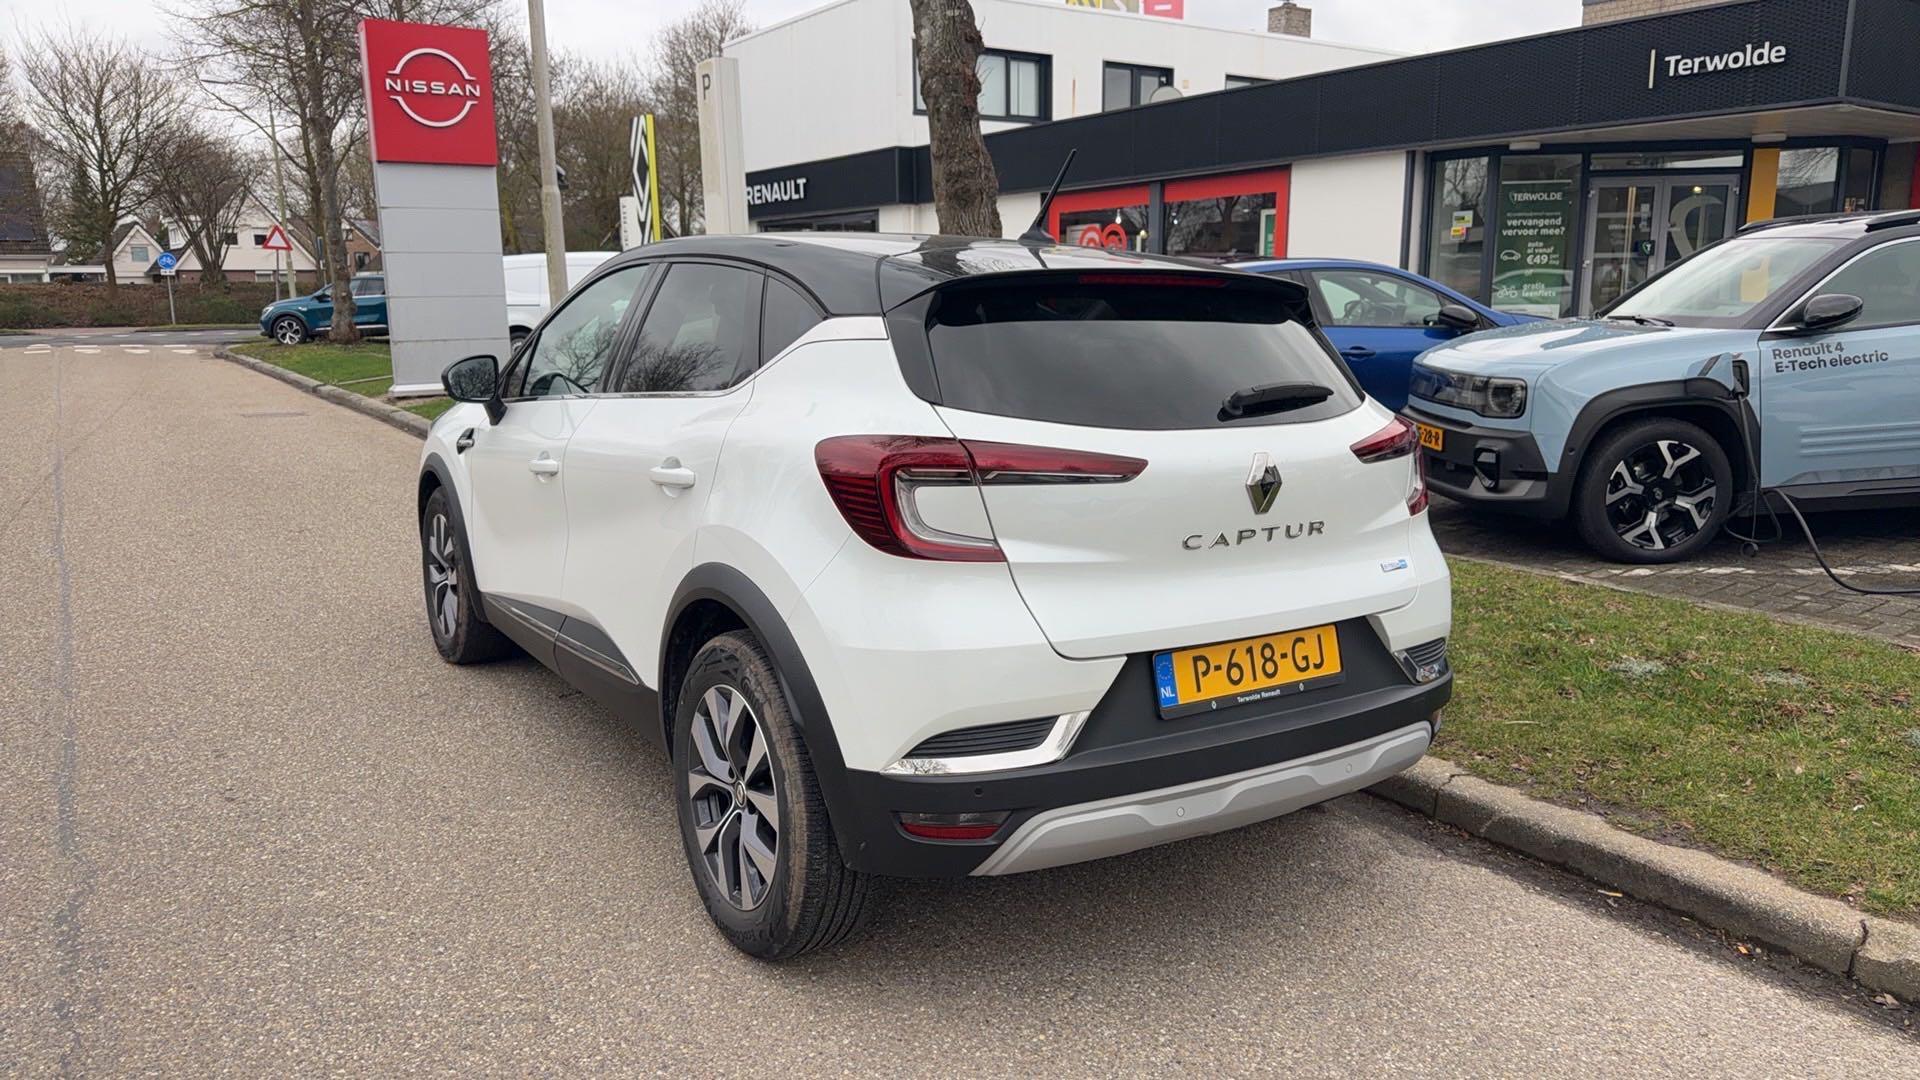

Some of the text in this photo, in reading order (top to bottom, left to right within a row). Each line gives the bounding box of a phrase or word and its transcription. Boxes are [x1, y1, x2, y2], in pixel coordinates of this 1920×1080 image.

[1665, 41, 1787, 77] Terwolde
[385, 78, 481, 97] NISSAN
[702, 73, 711, 100] P
[746, 178, 807, 205] RENAULT
[1513, 192, 1563, 202] TERWOLDE
[1507, 217, 1562, 227] vervangend
[1540, 227, 1565, 236] mee?
[1526, 254, 1549, 265] €49
[1773, 341, 1845, 360] Renault 4
[1775, 350, 1889, 374] E-Tech electric
[1182, 520, 1325, 551] CAPTUR
[1192, 634, 1325, 694] P-618-GJ
[1160, 687, 1176, 699] NL
[1237, 689, 1281, 704] Terwolde Renault
